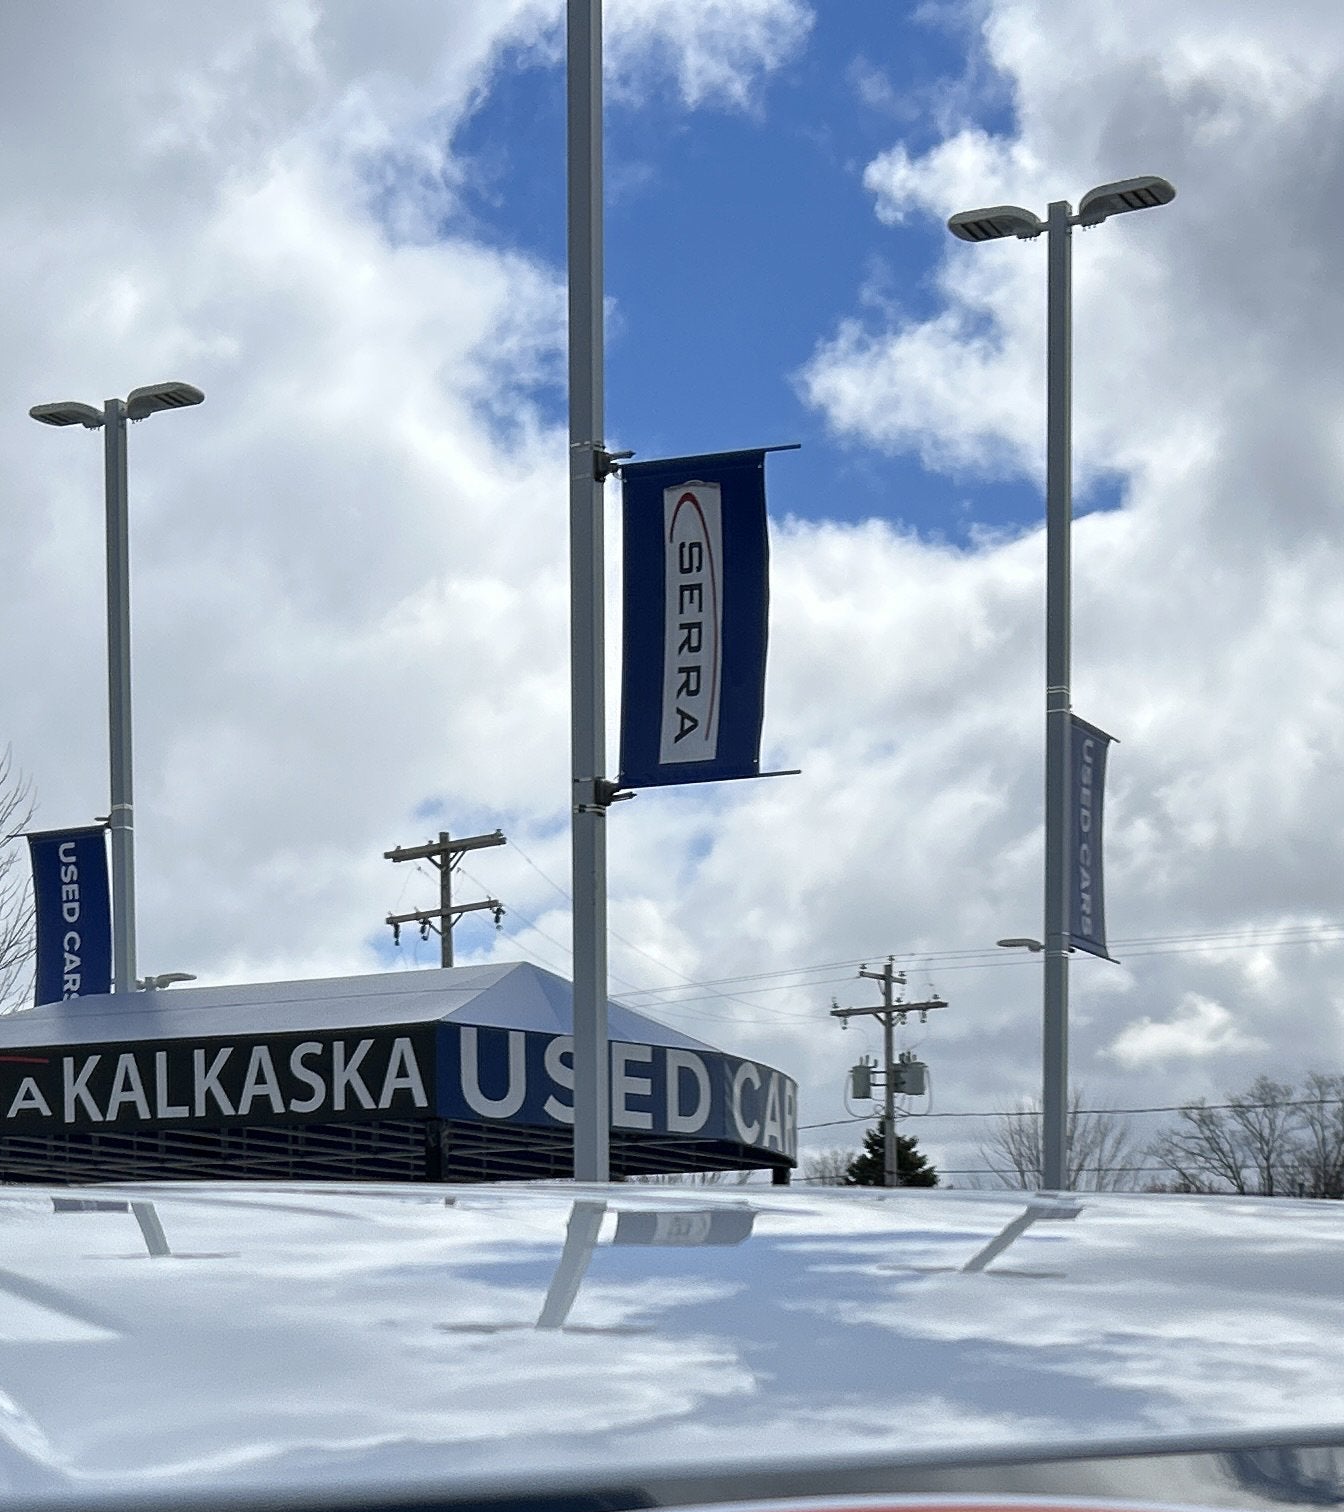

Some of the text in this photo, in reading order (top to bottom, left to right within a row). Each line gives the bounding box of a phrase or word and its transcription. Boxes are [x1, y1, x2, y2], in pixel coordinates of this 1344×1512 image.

[674, 541, 704, 744] SERRA
[58, 841, 81, 924] USED
[62, 1036, 430, 1125] KALKASKA
